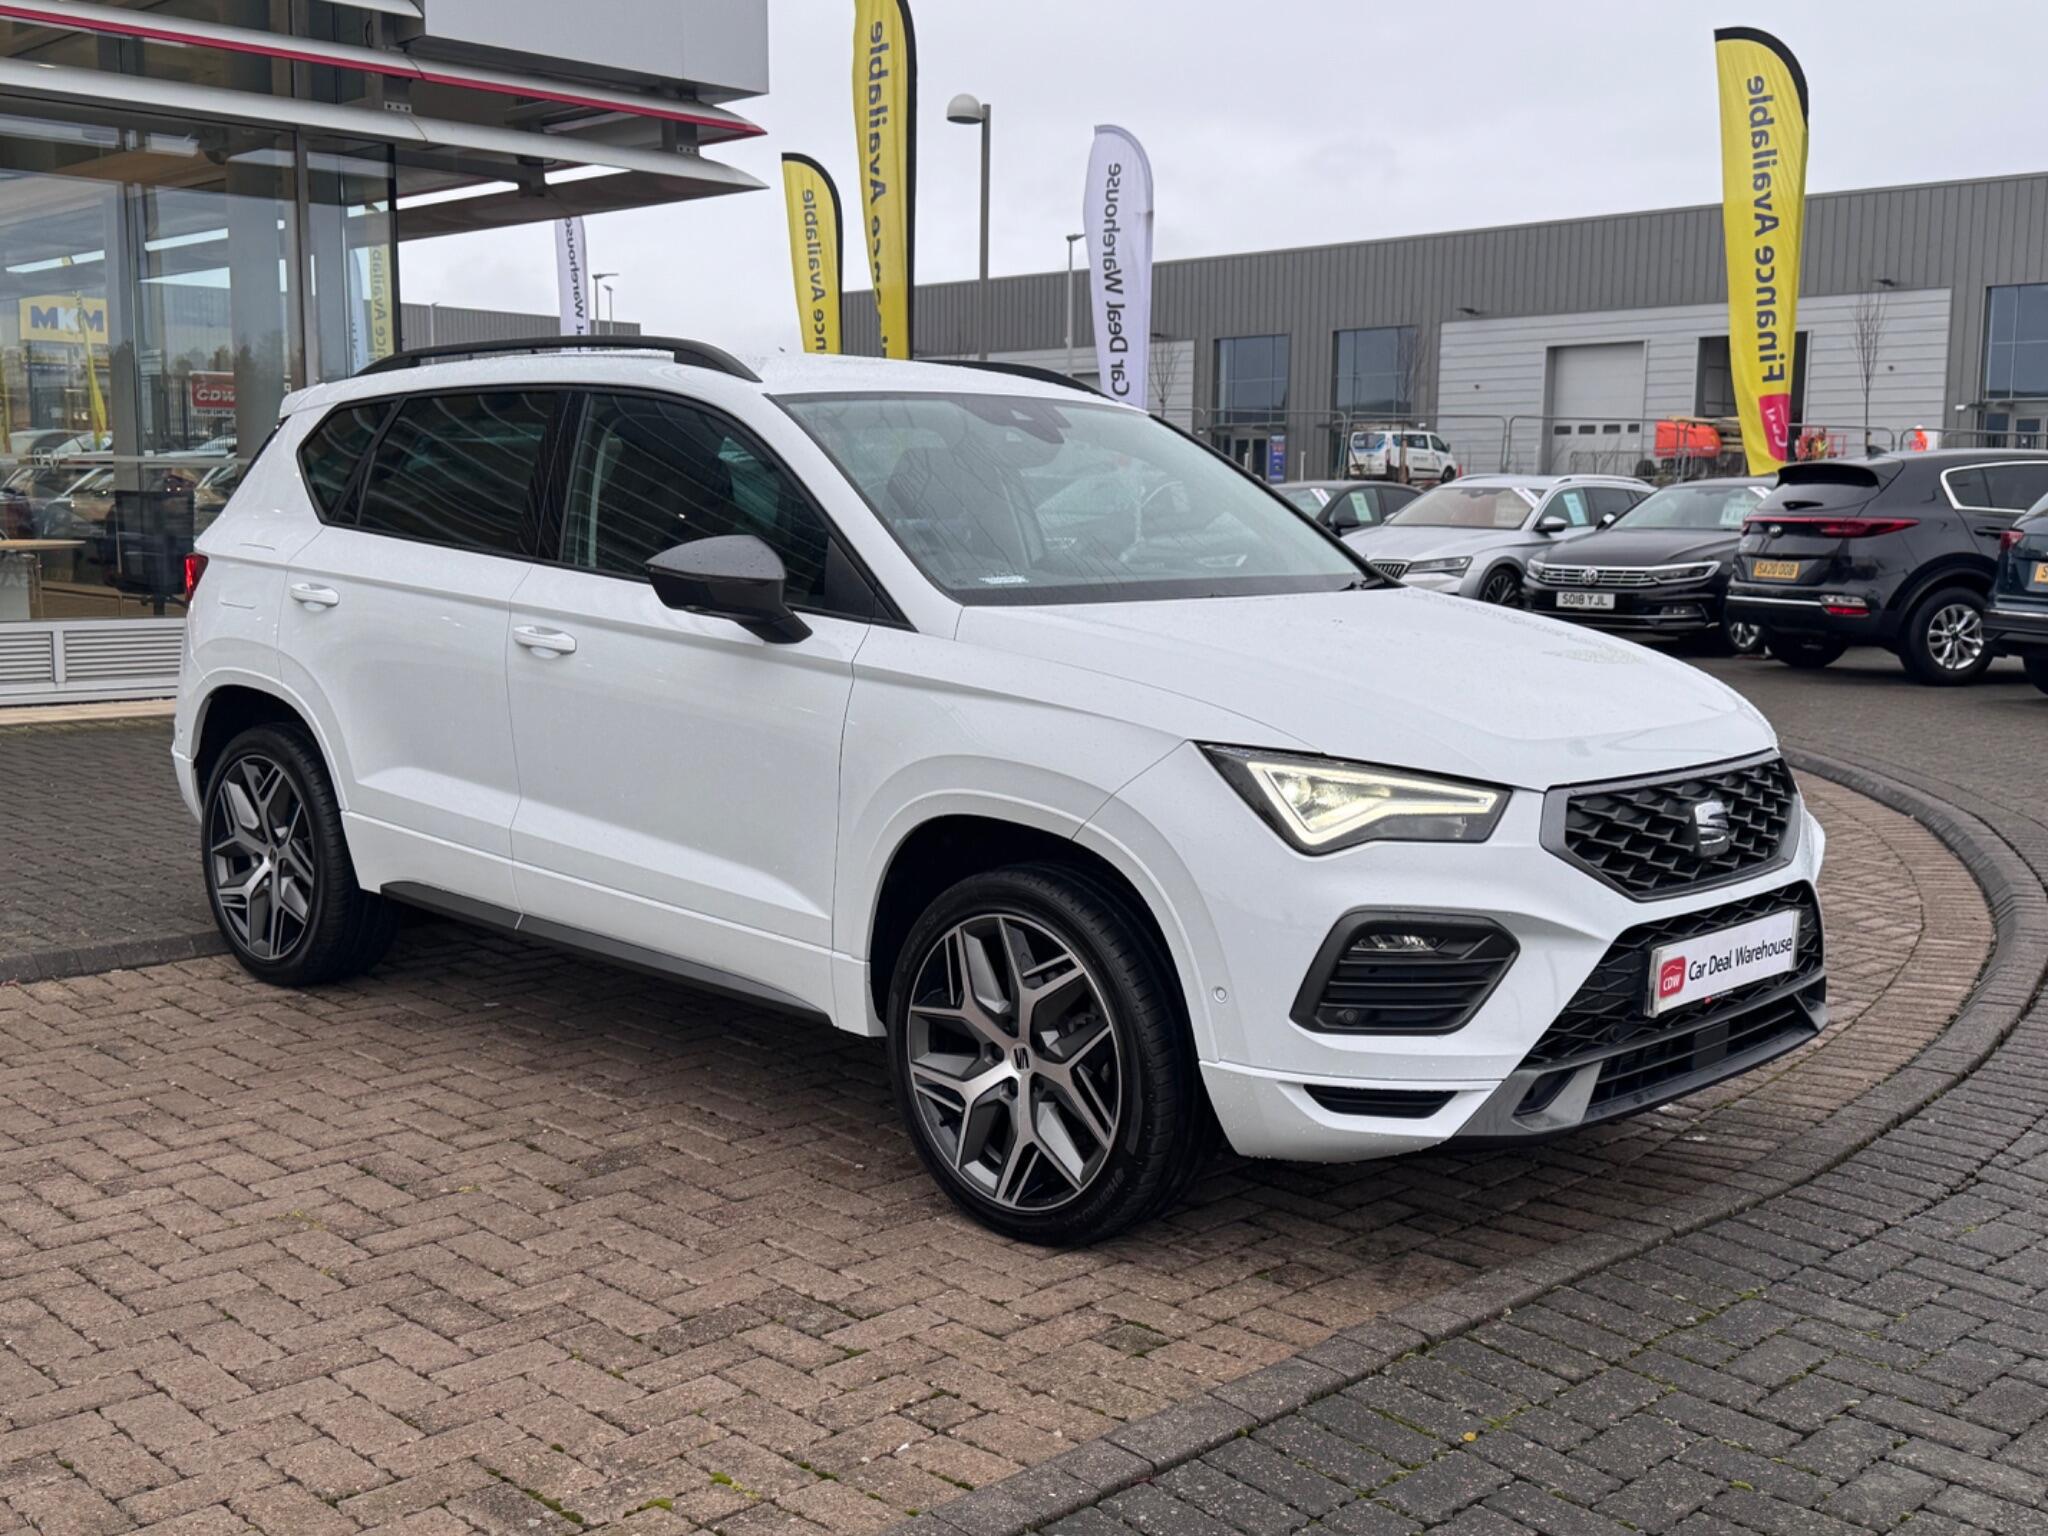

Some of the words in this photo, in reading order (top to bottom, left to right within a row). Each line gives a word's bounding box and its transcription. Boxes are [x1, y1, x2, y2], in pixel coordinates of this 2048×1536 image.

[30, 305, 104, 333] MKM
[1587, 595, 1608, 606] YJL
[1688, 960, 1706, 982] Car
[1708, 950, 1732, 976] Deal
[1735, 937, 1793, 967] Warehouse
[1663, 974, 1681, 992] CDW
